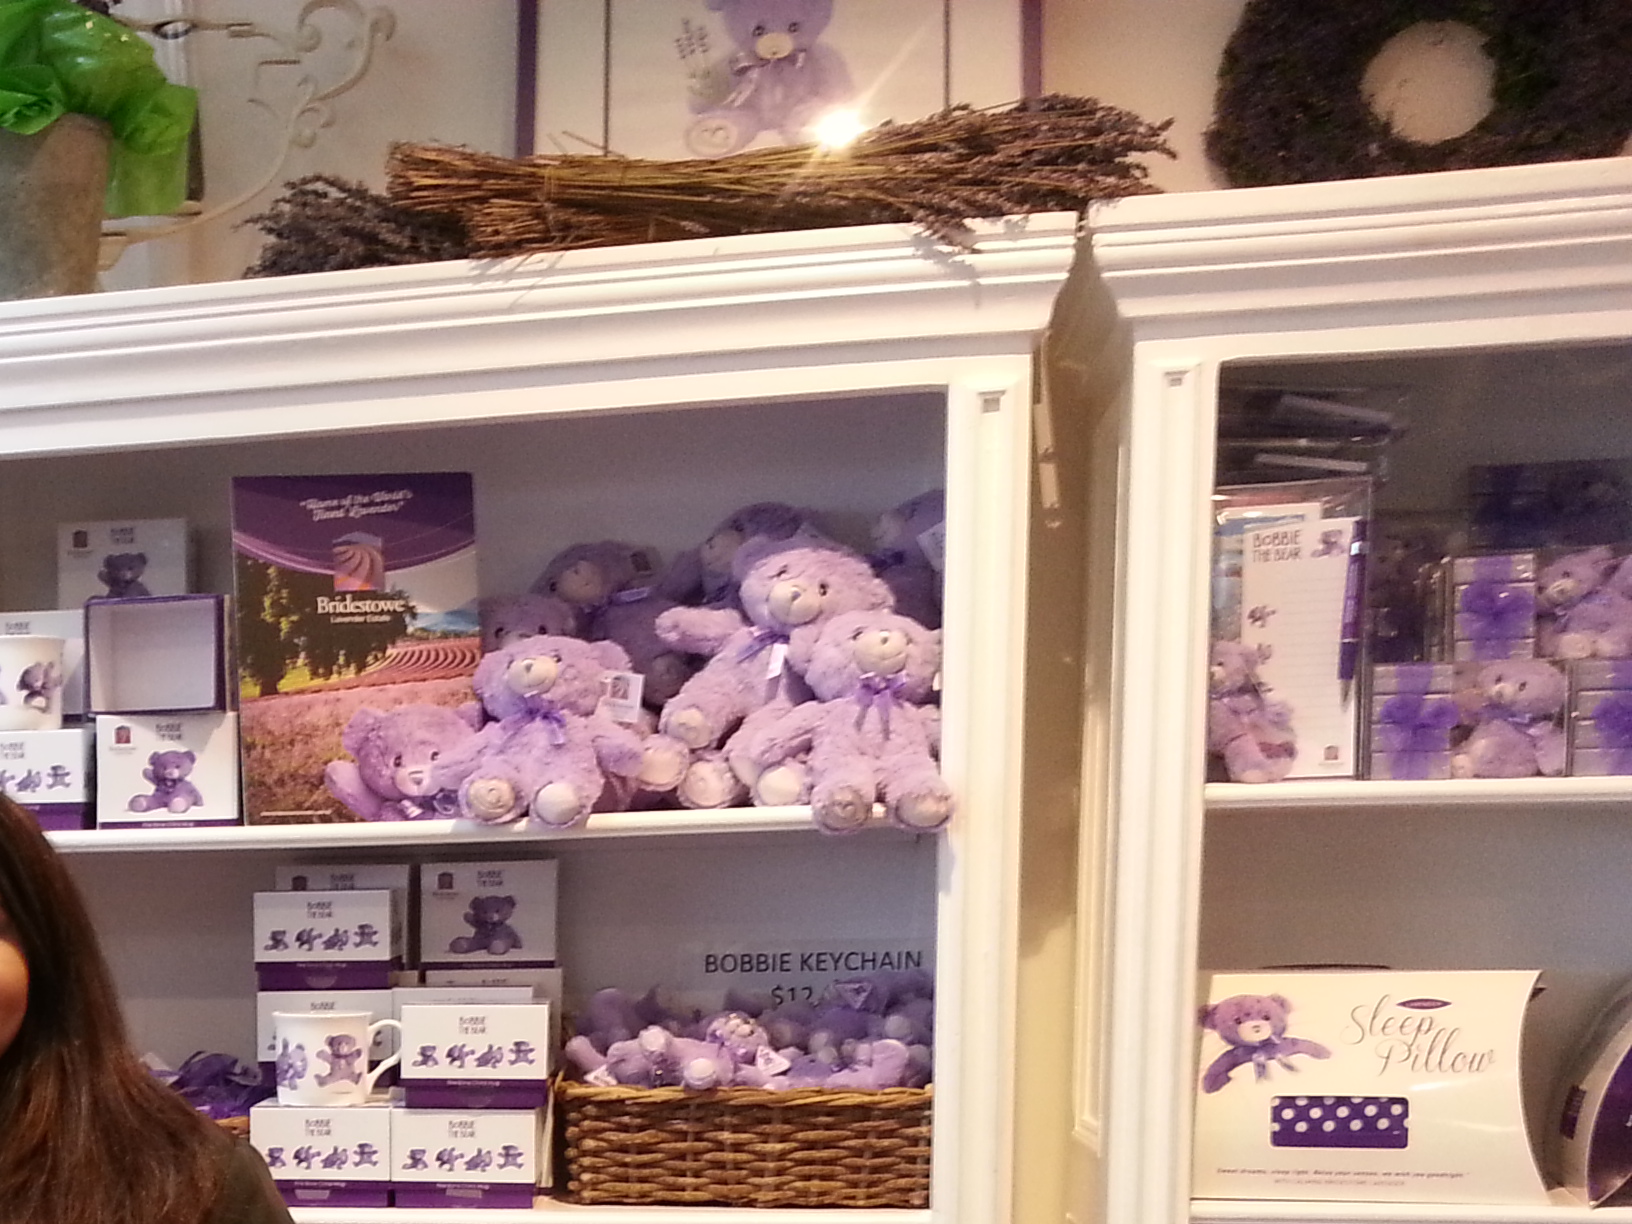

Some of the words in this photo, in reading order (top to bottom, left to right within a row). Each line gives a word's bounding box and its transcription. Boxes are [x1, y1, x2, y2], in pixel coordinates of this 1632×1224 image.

[1253, 530, 1302, 548] BOBBIE
[1253, 549, 1272, 563] THE
[1274, 547, 1302, 562] BEAR
[316, 594, 407, 614] Bridestowe
[705, 952, 792, 973] BOBBIE
[800, 950, 923, 972] KEYCHAIN
[1340, 993, 1438, 1048] Sleep
[1375, 1027, 1496, 1077] Pillow
